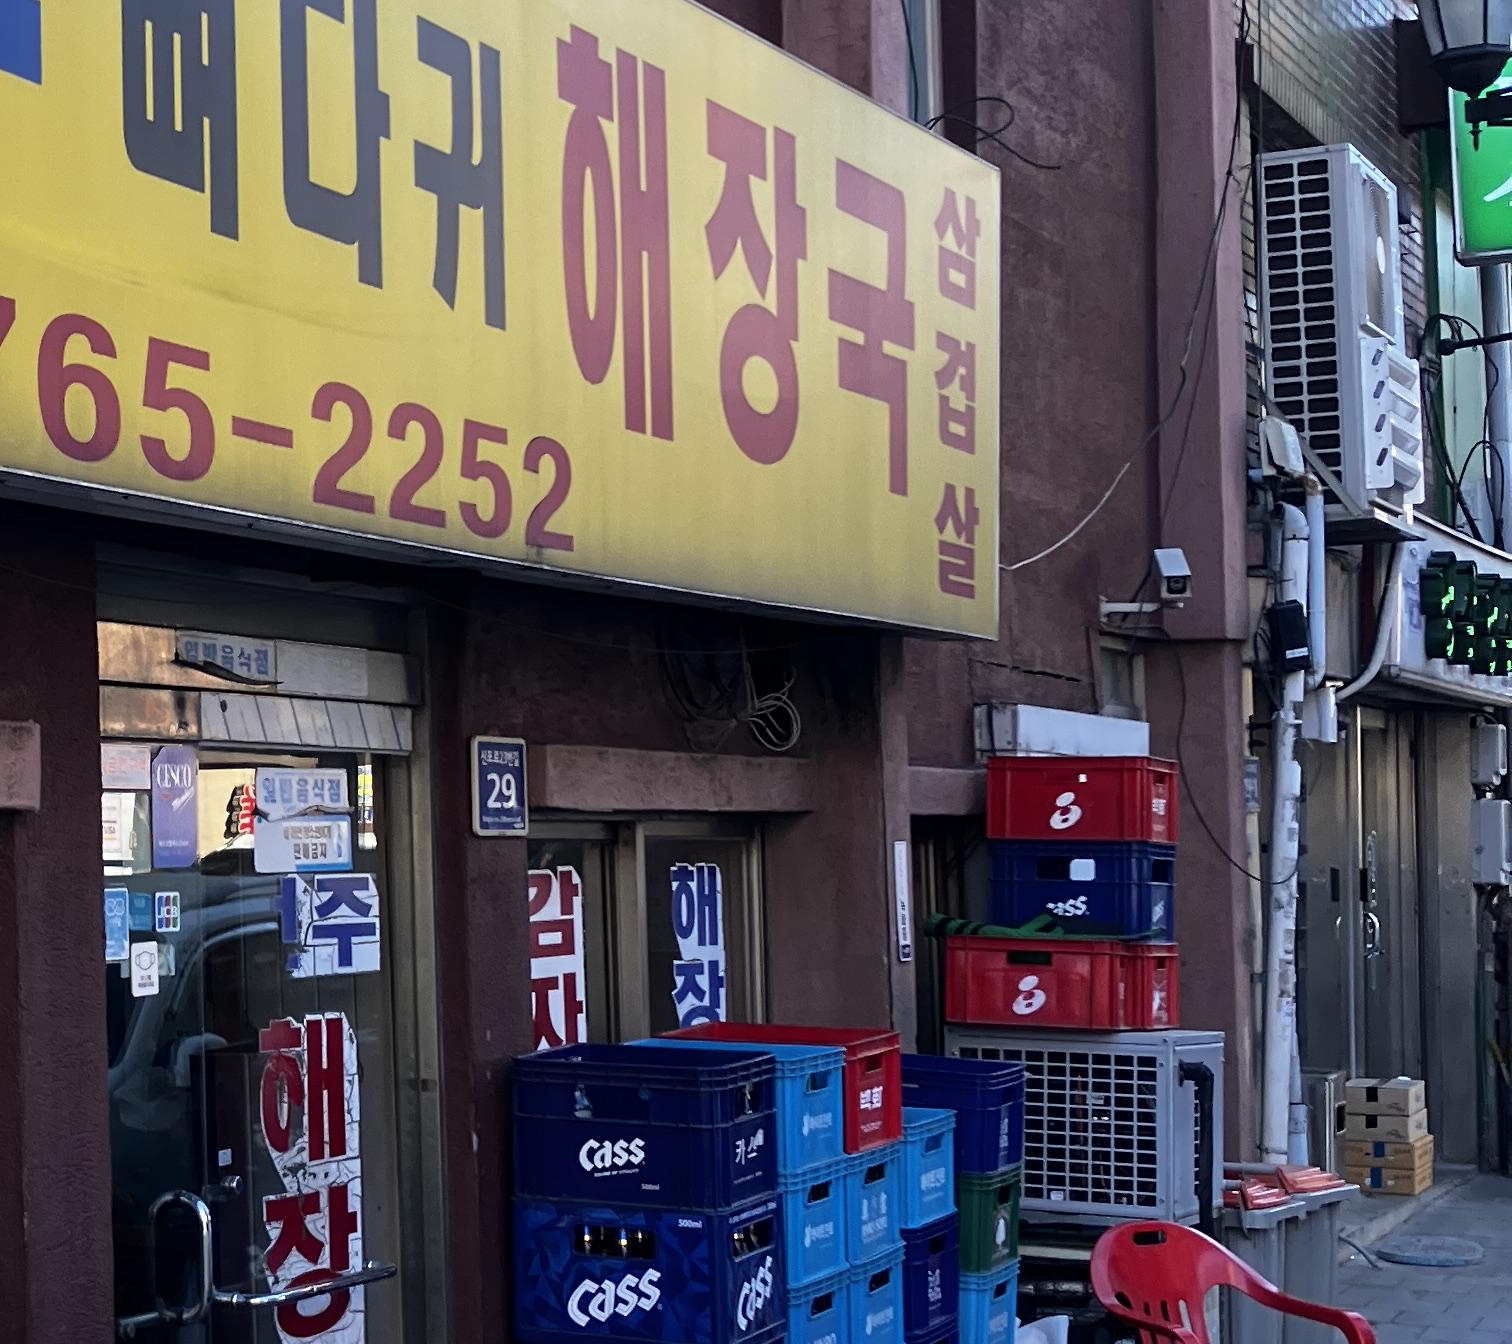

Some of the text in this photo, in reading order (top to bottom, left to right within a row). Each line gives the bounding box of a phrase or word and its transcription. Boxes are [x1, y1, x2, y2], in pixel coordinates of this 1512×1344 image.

[556, 23, 915, 498] 해장국
[934, 186, 980, 601] 삼겹살
[157, 763, 192, 788] CESCO
[487, 772, 517, 808] 29
[579, 1137, 646, 1172] Cass
[567, 1268, 662, 1327] Cass
[738, 1256, 773, 1331] Cass
